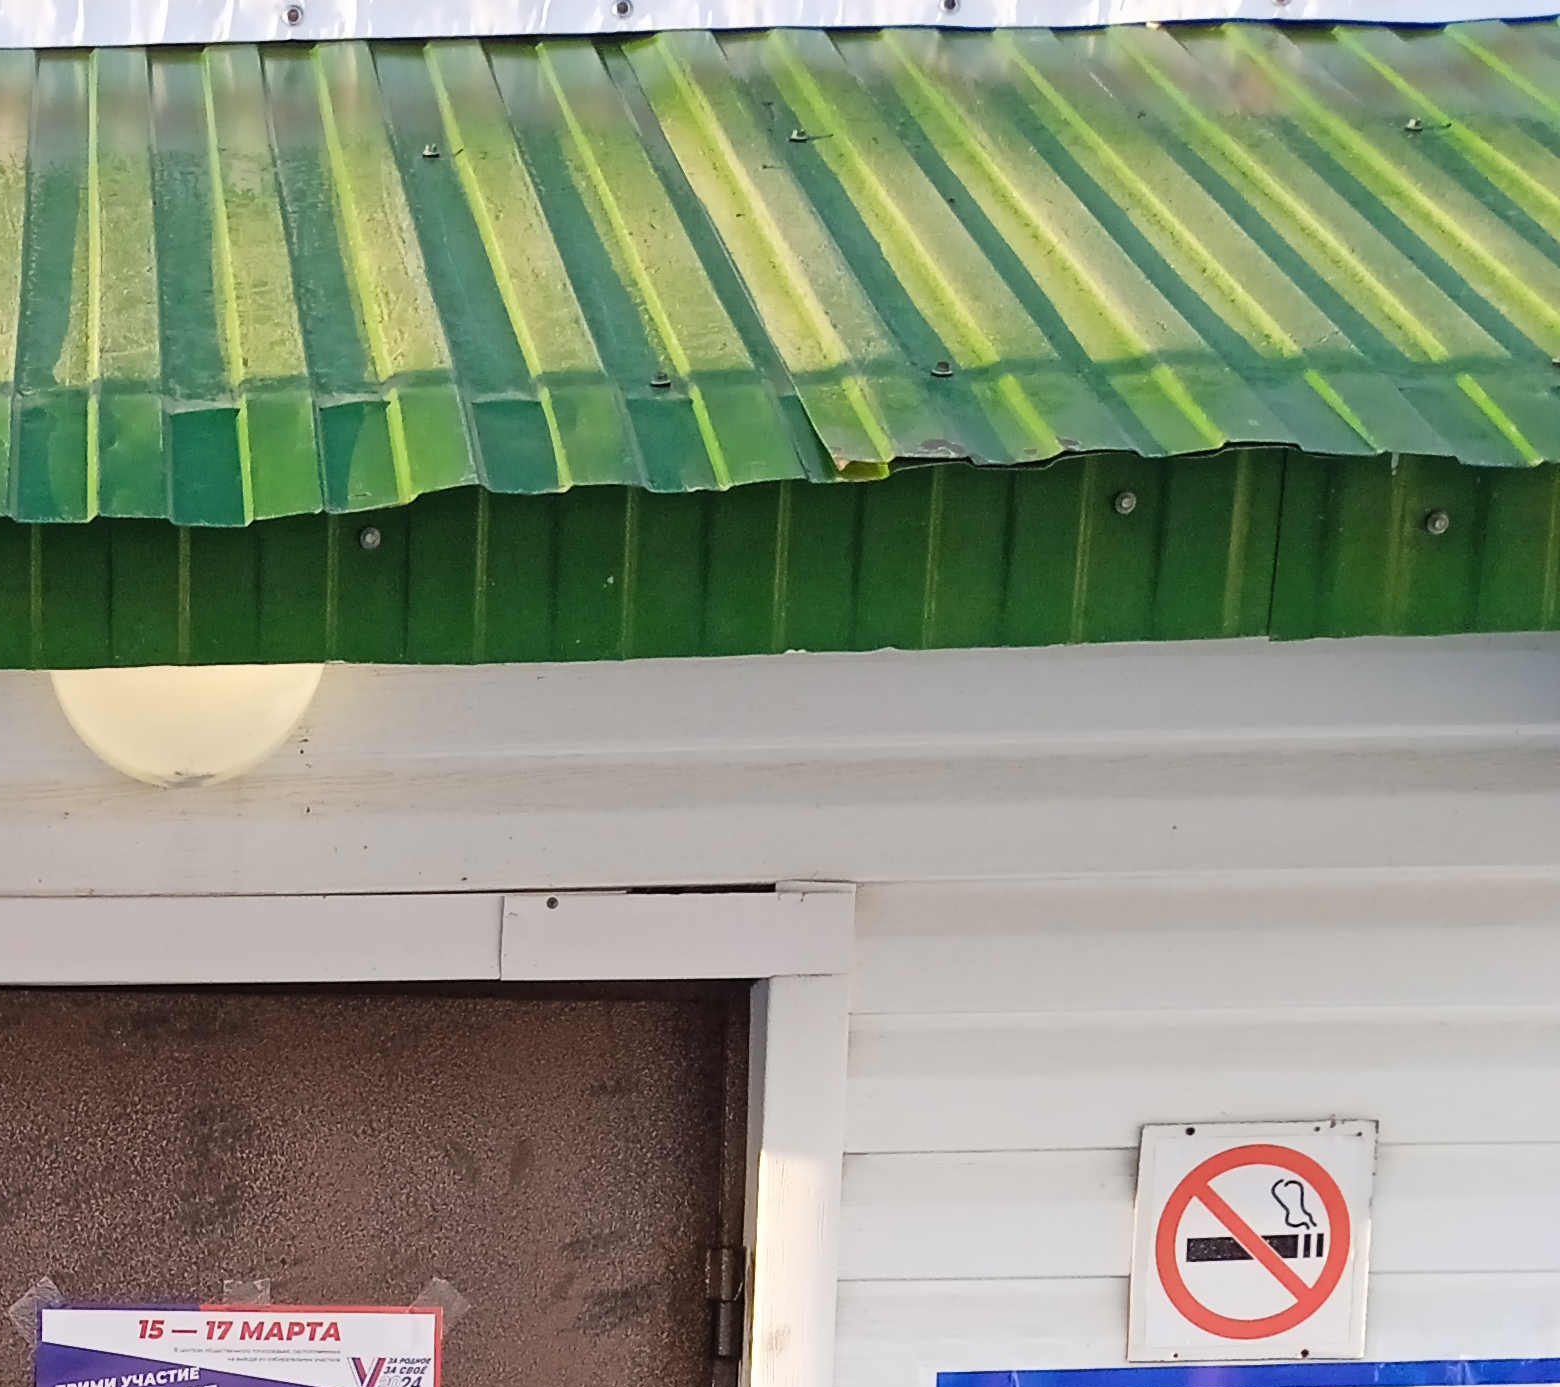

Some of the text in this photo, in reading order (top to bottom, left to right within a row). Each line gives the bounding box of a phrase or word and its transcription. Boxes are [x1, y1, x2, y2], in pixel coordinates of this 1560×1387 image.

[138, 1319, 165, 1340] 15
[206, 1320, 233, 1341] 17
[240, 1320, 341, 1342] МАРТА
